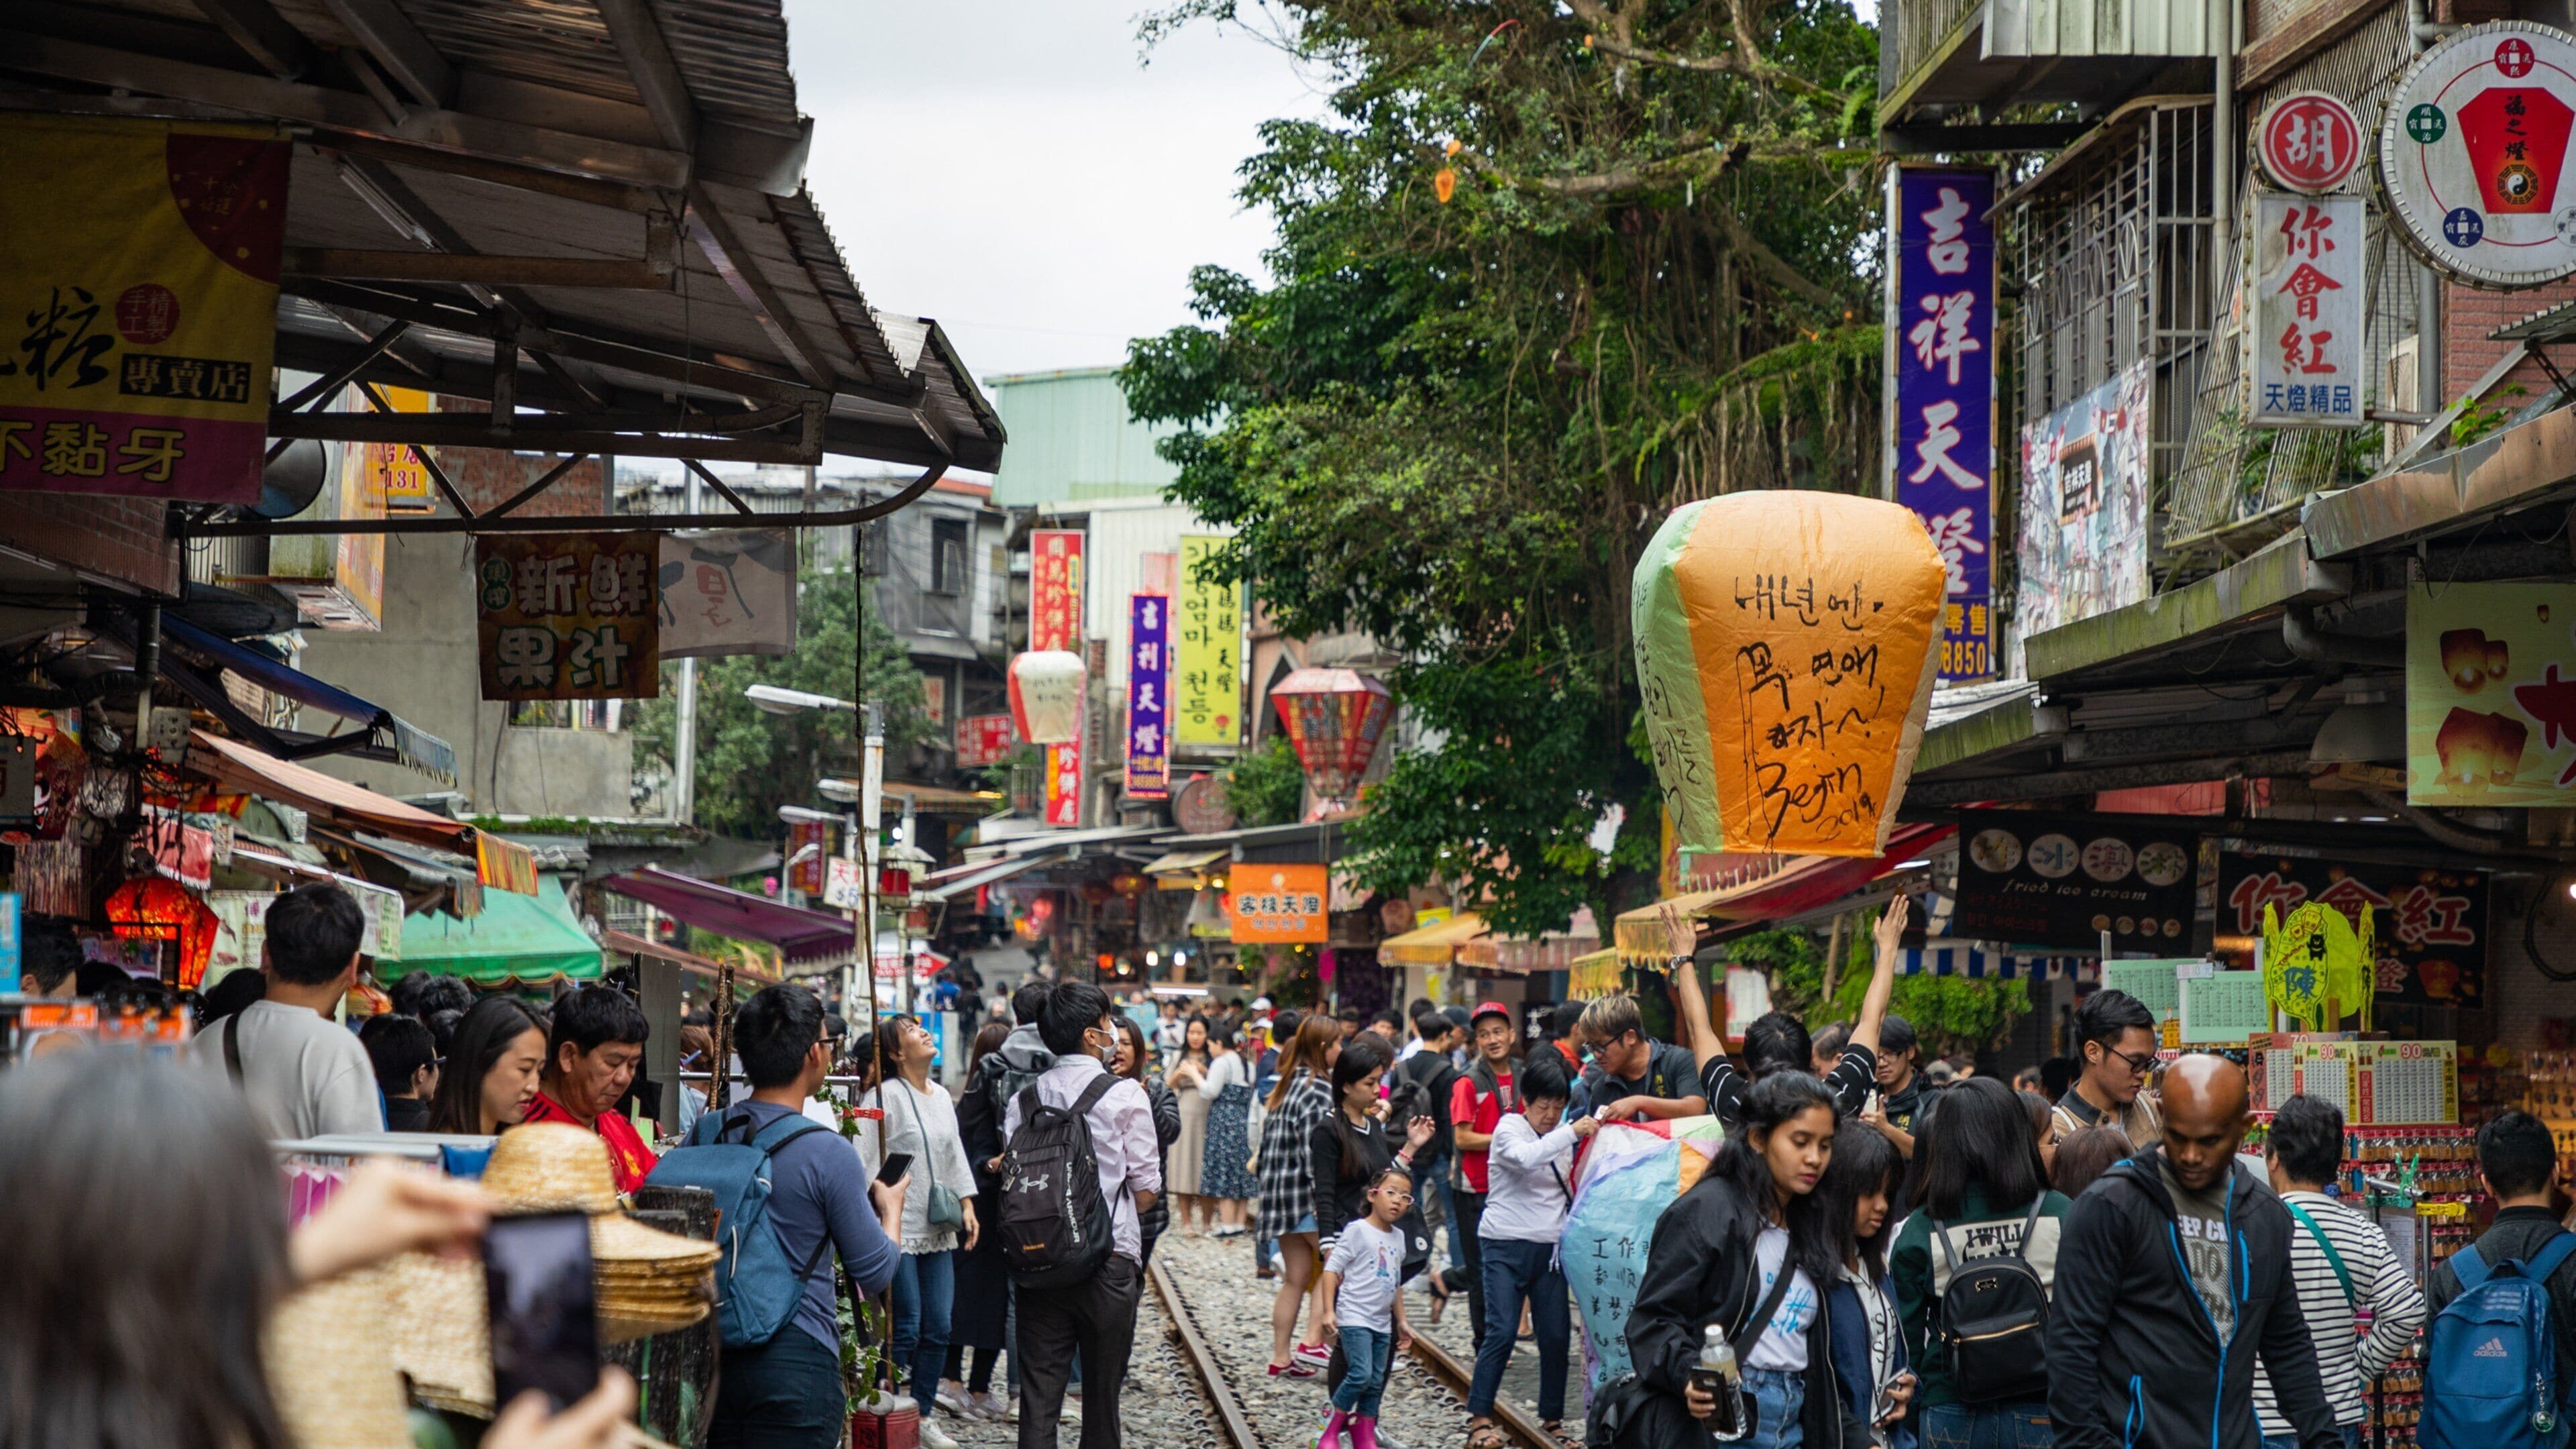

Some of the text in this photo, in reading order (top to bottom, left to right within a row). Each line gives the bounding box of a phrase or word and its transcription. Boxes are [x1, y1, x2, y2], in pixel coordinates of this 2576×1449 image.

[2286, 113, 2335, 172] 胡
[2504, 94, 2529, 161] 福之燈
[2279, 205, 2343, 376] 你會紅
[125, 356, 250, 401] 專賣店
[1908, 186, 1985, 595] 吉祥天燈
[2265, 383, 2353, 414] 天燈精品
[517, 550, 651, 617] 新鮮
[496, 625, 629, 689] 果汁
[2284, 965, 2318, 1002] 陳
[2320, 1044, 2335, 1060] 90
[2400, 1043, 2423, 1061] 90
[1066, 1197, 1080, 1243] ARMOUR
[2473, 1349, 2508, 1358] adidas
